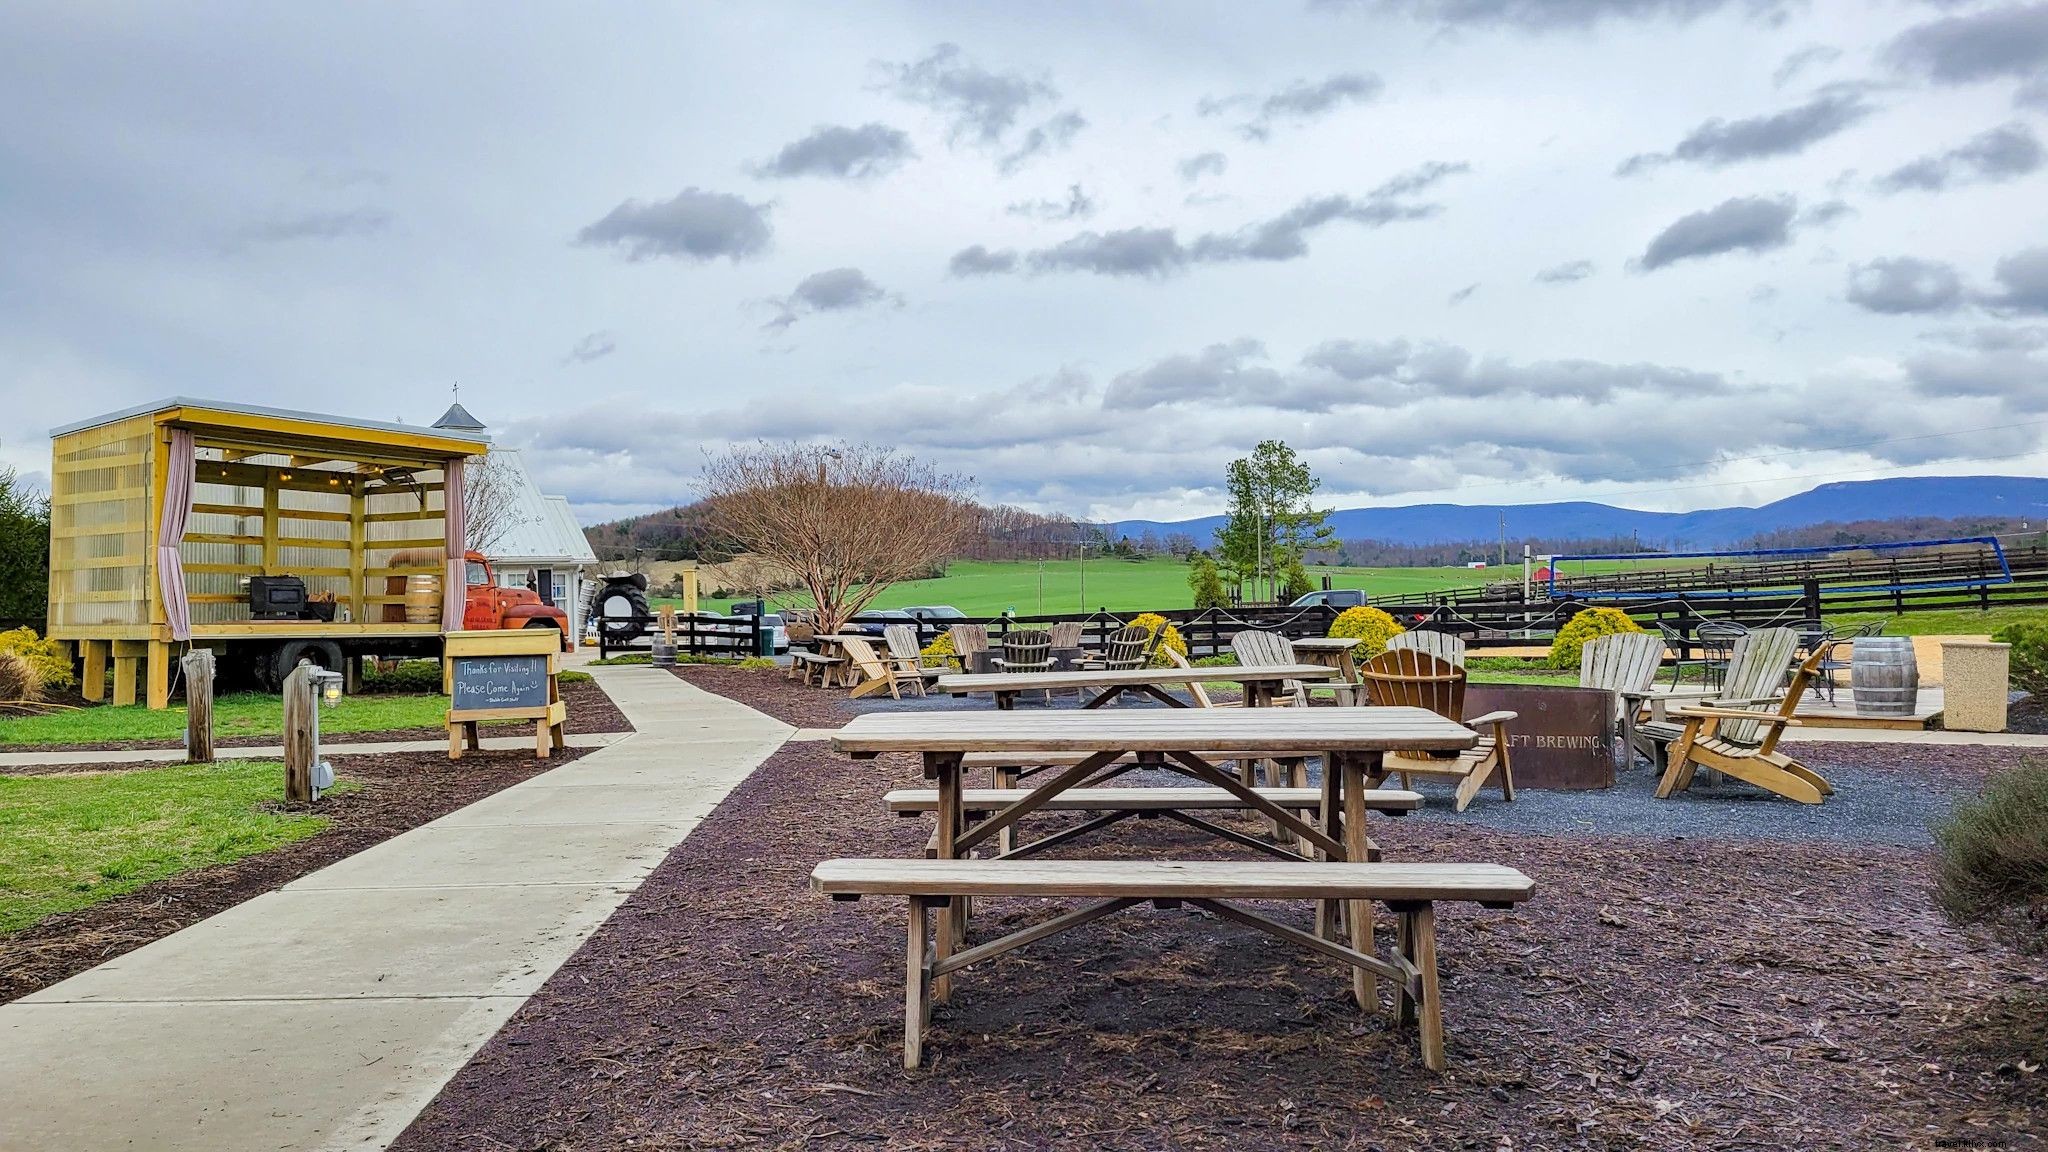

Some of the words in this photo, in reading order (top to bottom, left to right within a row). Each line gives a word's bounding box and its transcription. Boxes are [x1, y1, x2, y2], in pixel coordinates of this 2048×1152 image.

[460, 661, 487, 676] Thanks
[489, 661, 502, 674] for
[457, 681, 486, 695] Please
[486, 680, 509, 695] Come
[511, 680, 530, 696] Again
[1535, 735, 1600, 749] BREWING
